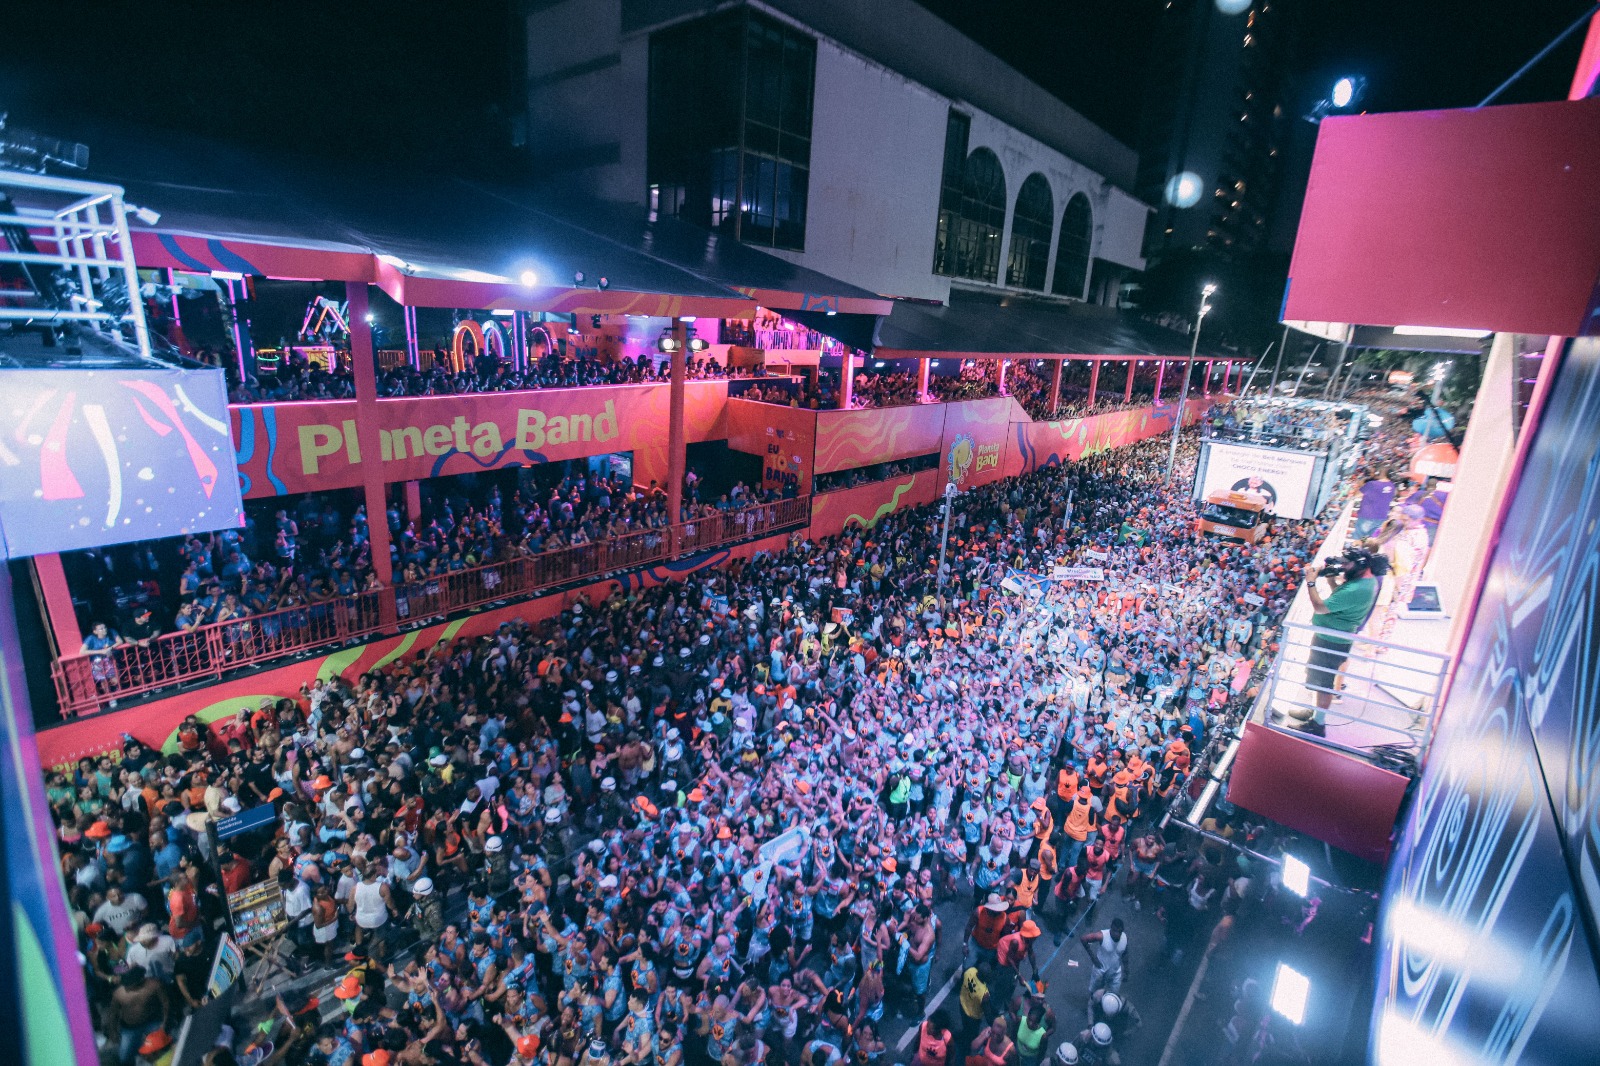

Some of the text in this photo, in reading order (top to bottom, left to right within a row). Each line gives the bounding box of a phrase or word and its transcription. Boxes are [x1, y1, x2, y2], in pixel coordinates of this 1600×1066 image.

[515, 399, 619, 450] Band
[768, 443, 779, 454] EU
[978, 442, 1000, 456] Planeta
[975, 452, 999, 472] Band
